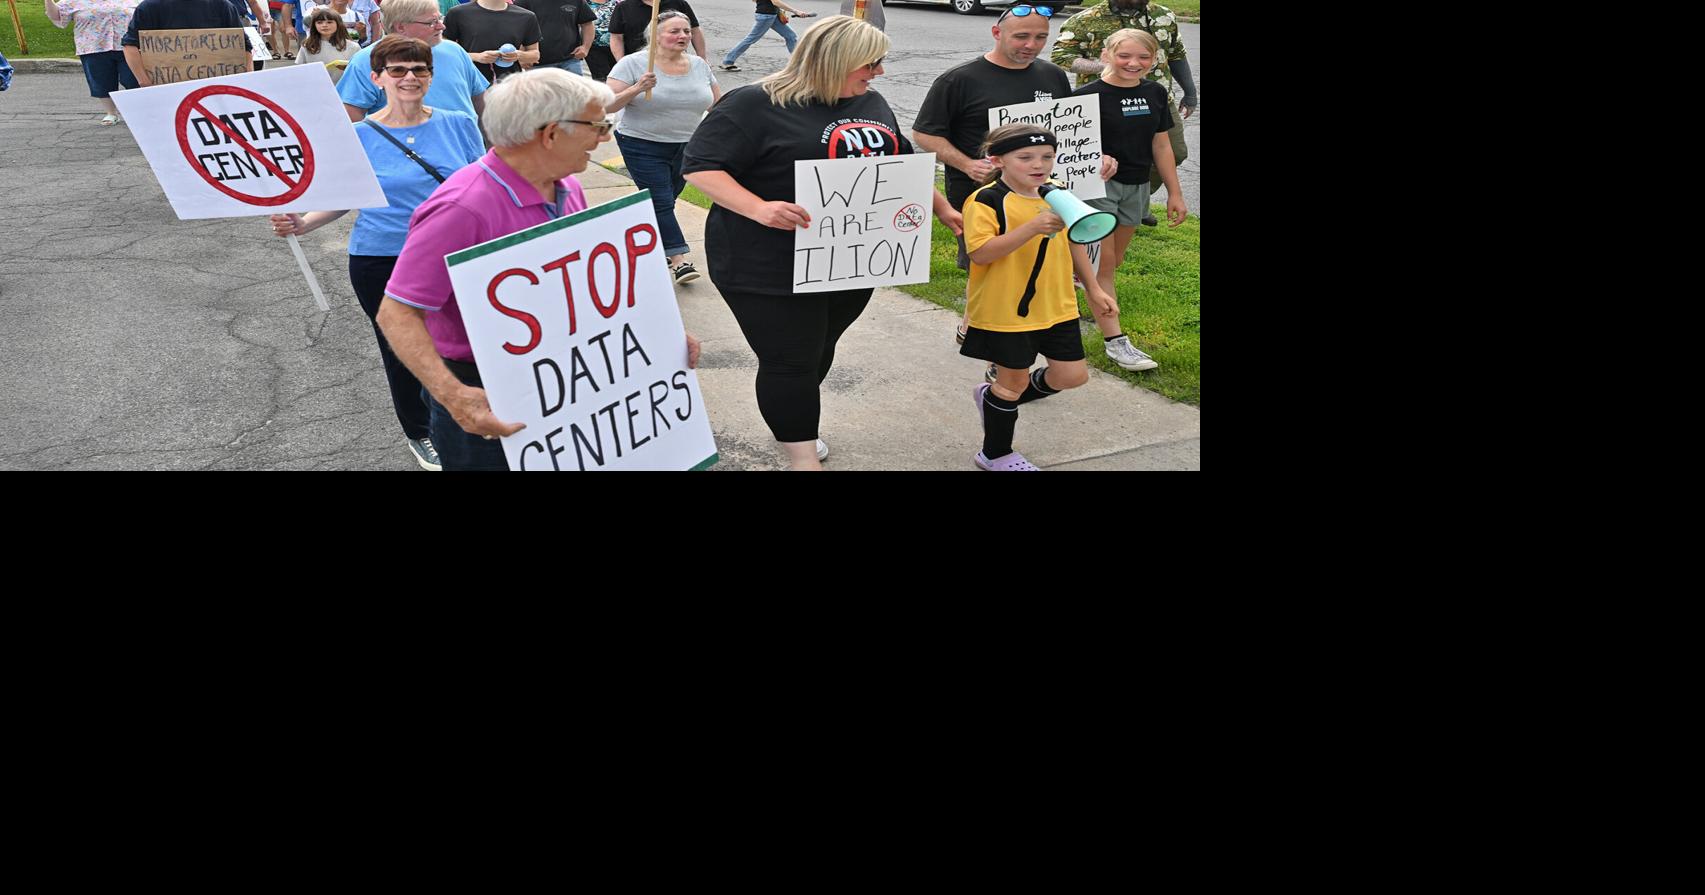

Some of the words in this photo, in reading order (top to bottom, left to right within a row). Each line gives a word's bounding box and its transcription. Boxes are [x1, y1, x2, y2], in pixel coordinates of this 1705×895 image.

[191, 109, 287, 147] DATA
[999, 102, 1086, 131] Remington
[1054, 119, 1093, 136] people
[821, 121, 838, 144] PROTECT
[840, 127, 885, 152] NO
[199, 144, 304, 182] CENTER
[1057, 151, 1101, 165] Centers
[814, 161, 904, 207] WE
[906, 206, 918, 214] No
[819, 212, 883, 238] ARE
[796, 235, 918, 286] ILION
[487, 223, 658, 356] STOP
[533, 322, 652, 418] DATA
